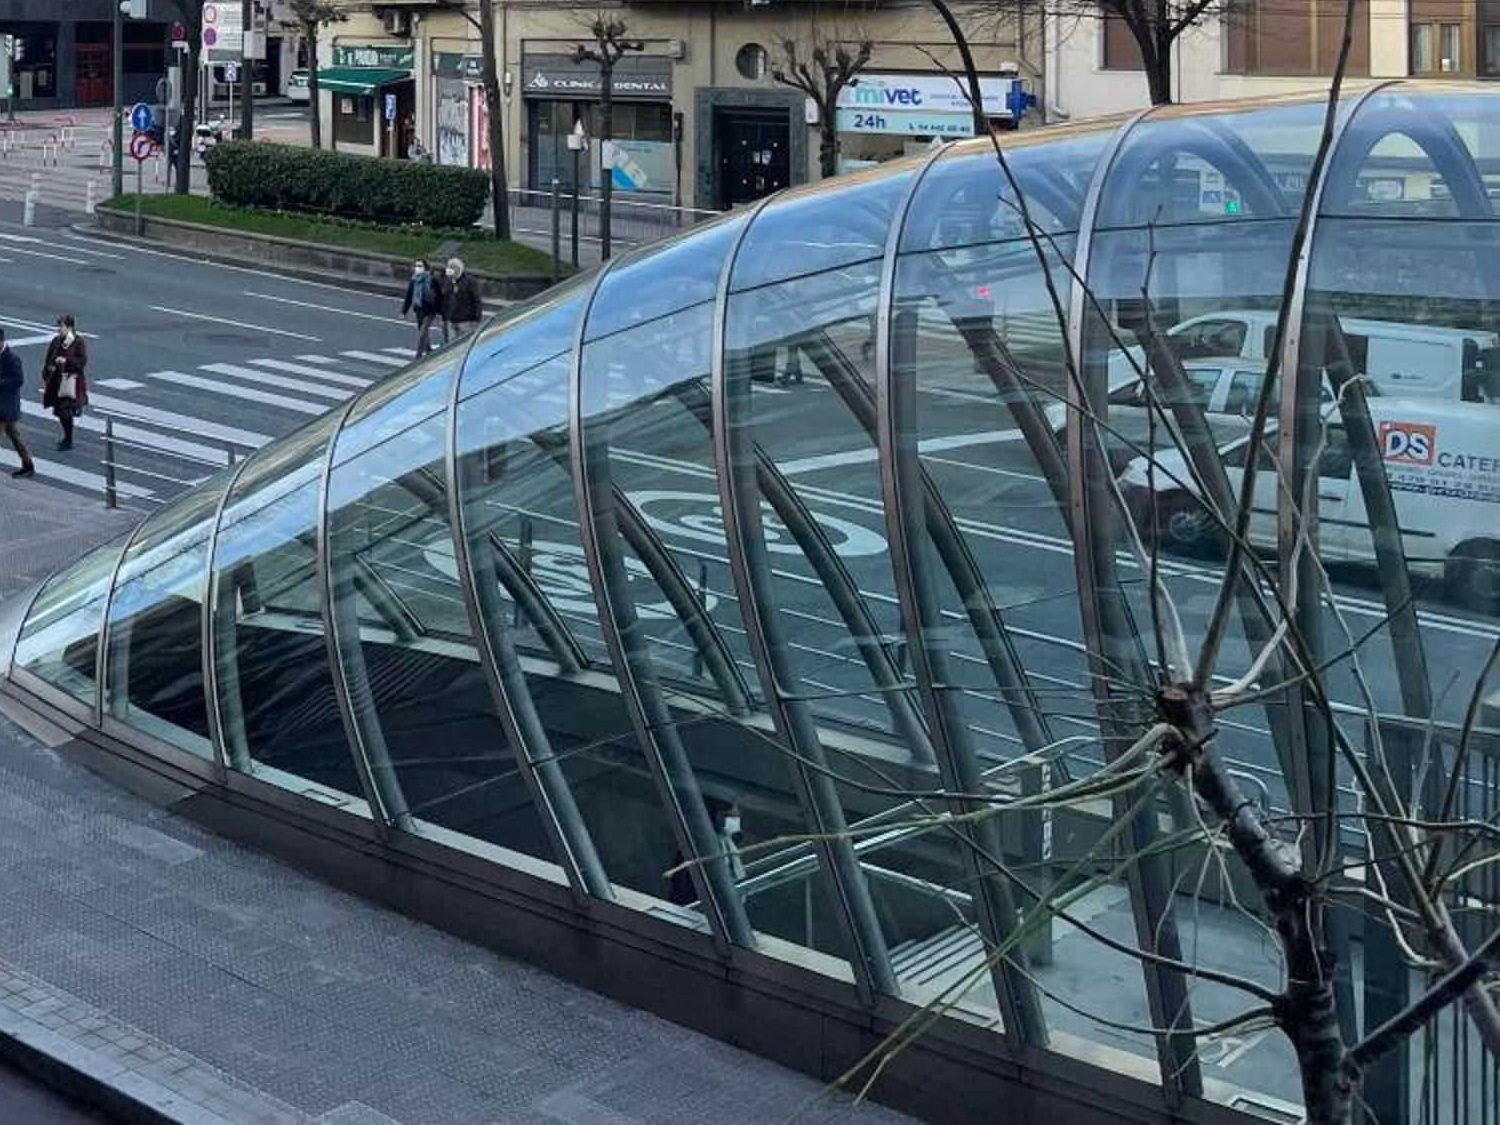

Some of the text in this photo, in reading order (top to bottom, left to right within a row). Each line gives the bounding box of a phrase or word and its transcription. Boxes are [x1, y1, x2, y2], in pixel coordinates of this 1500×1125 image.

[553, 79, 667, 90] CLINIC DENTAL
[856, 86, 923, 106] mivet
[854, 113, 886, 129] 24h
[1385, 430, 1429, 460] DS
